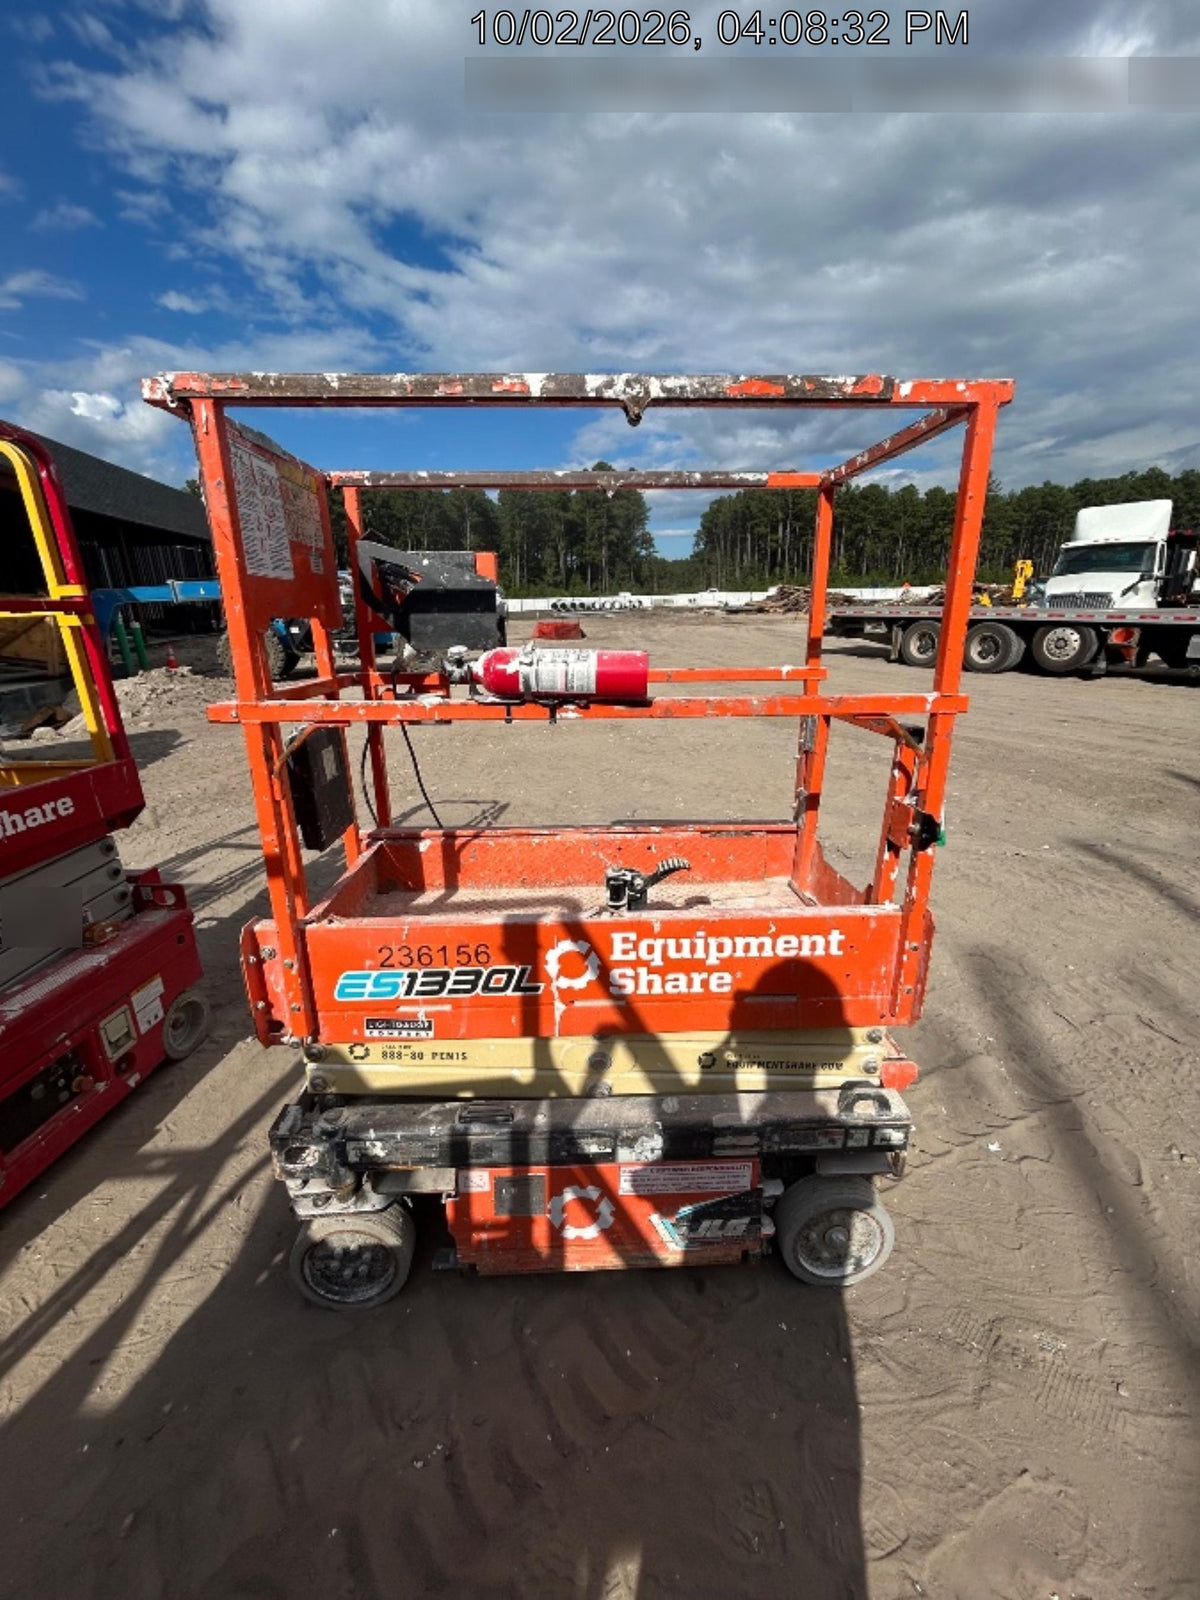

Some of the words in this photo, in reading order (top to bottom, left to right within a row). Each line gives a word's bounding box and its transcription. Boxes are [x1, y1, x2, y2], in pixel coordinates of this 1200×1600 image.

[377, 943, 492, 968] 236156
[609, 929, 846, 966] Equipment
[335, 966, 544, 1001] ES1330L
[608, 966, 733, 996] Share
